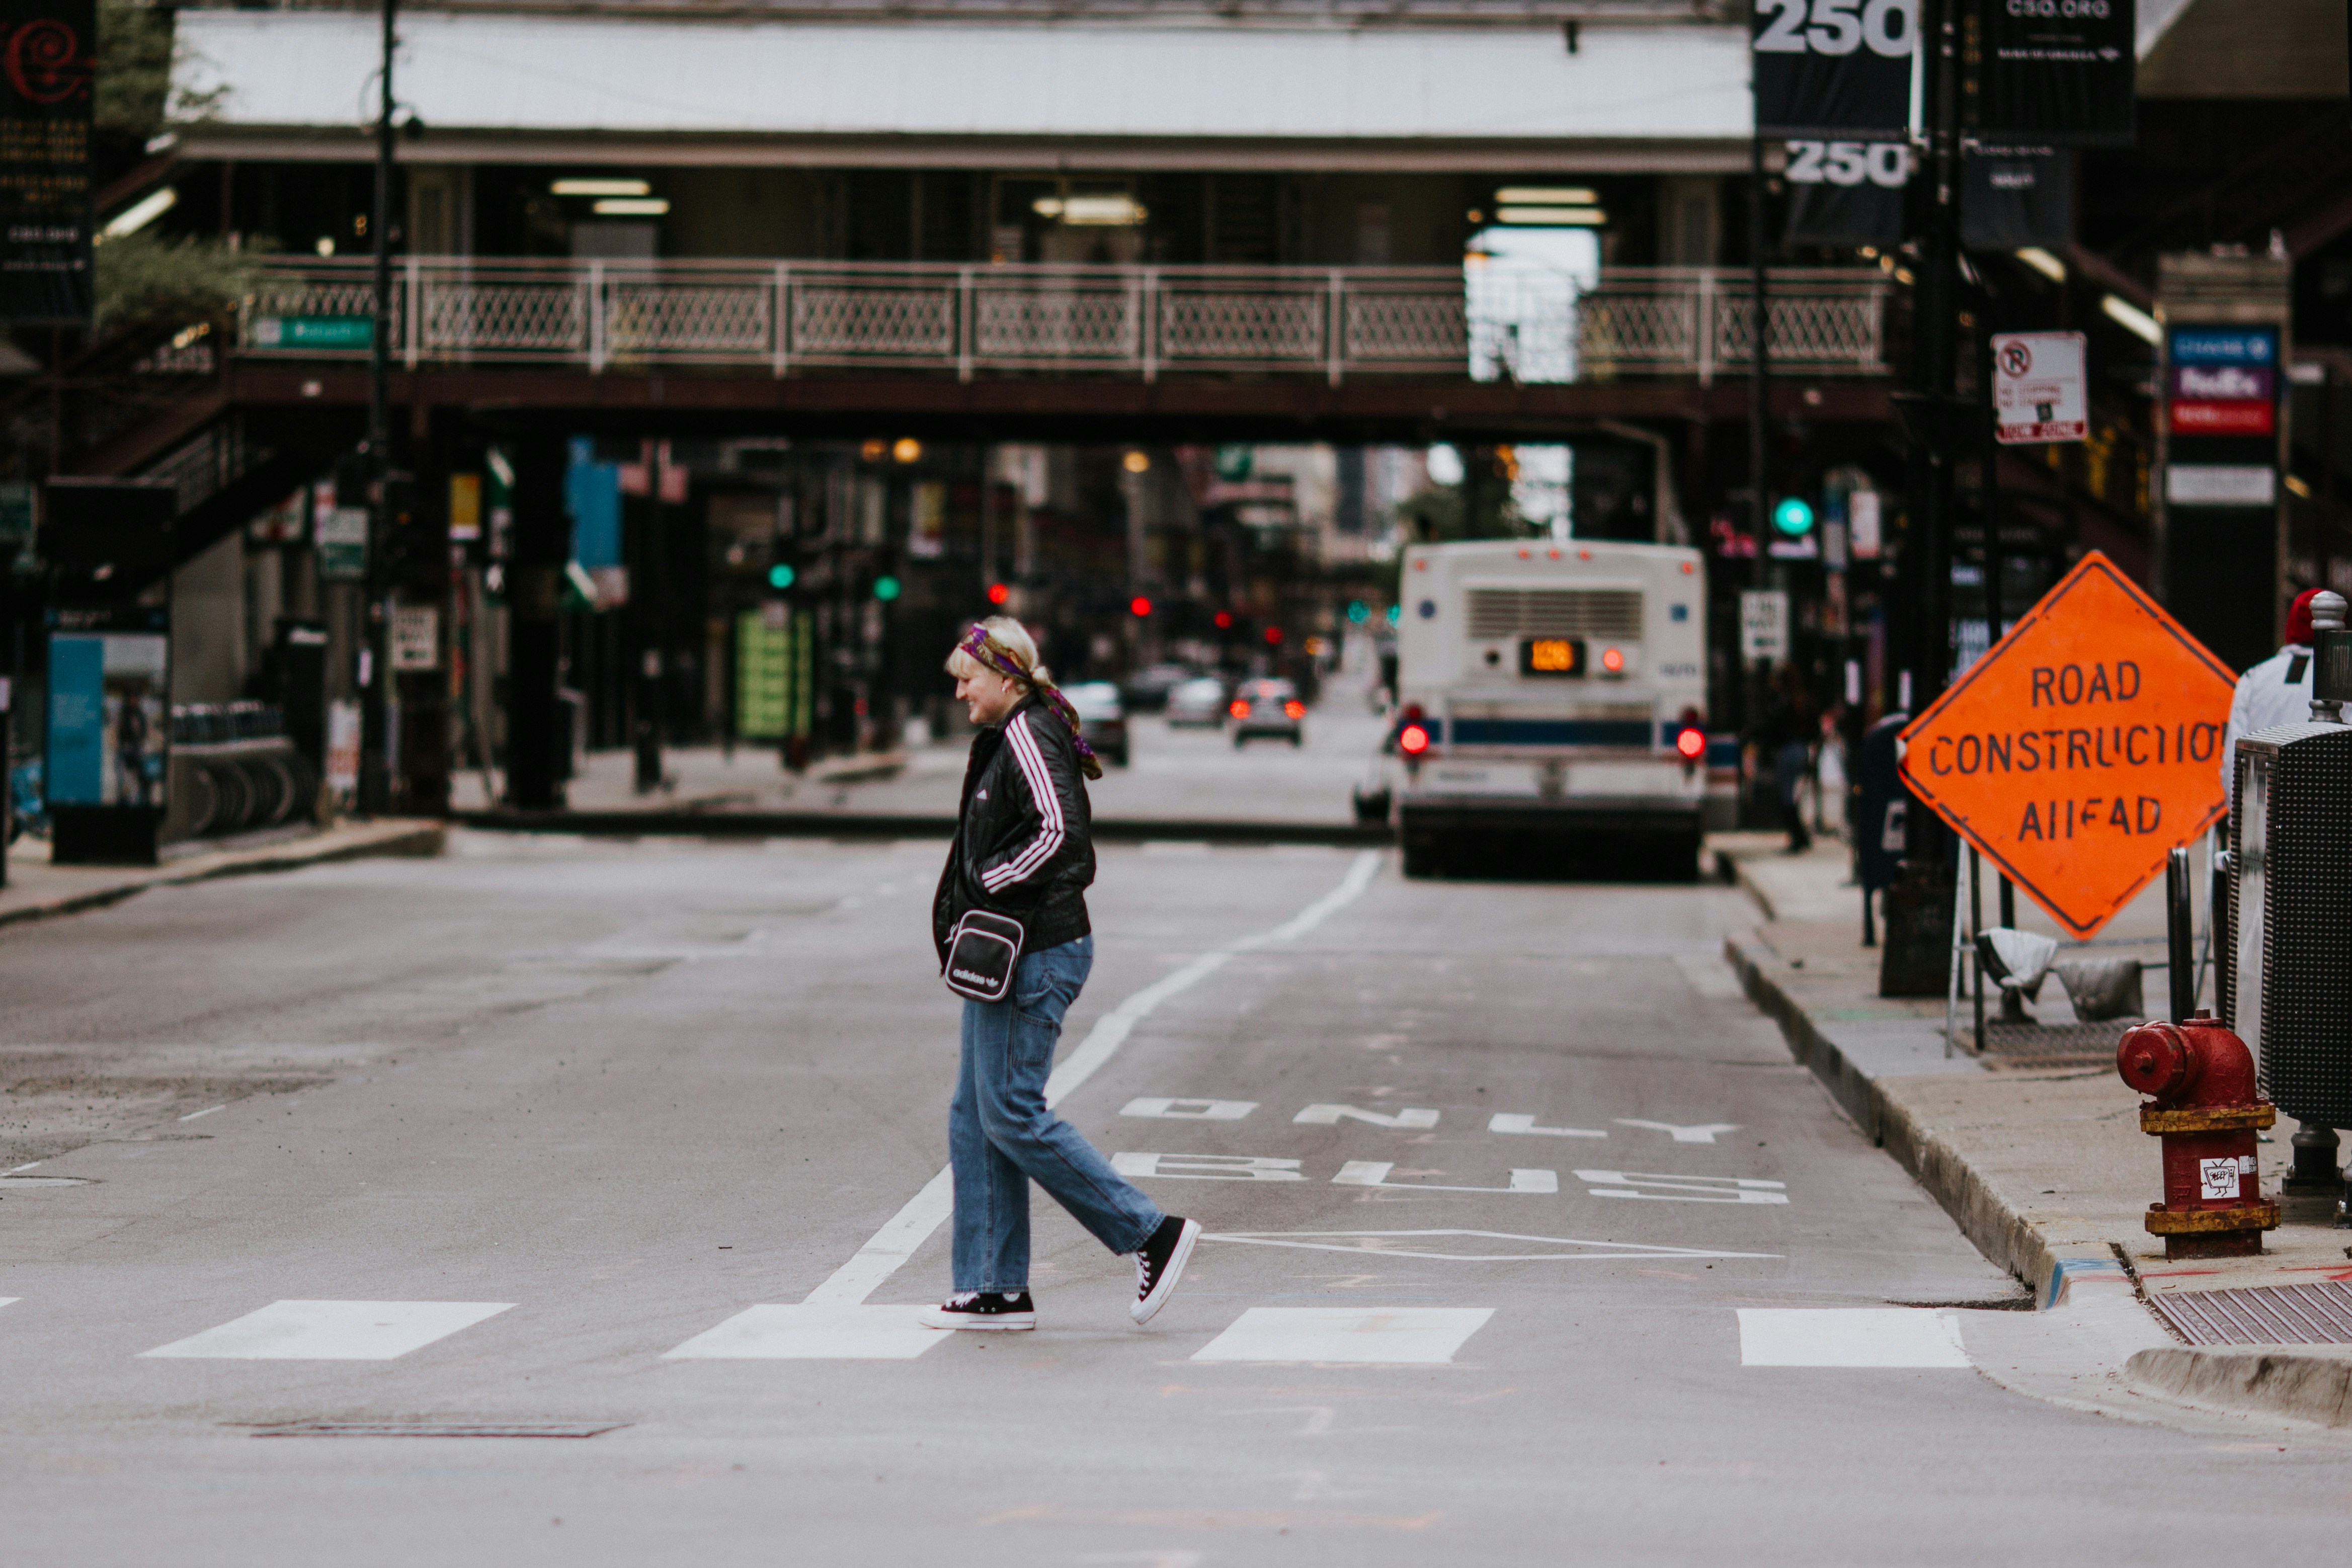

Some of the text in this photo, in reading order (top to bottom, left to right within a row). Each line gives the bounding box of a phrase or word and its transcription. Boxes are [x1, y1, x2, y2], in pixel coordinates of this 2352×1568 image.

[1754, 0, 1916, 57] 250
[1785, 140, 1910, 188] 250
[2032, 661, 2140, 708] ROAD
[953, 969, 985, 985] adidas
[1118, 1096, 1748, 1143] ONLY
[1109, 1151, 1790, 1204] BUS
